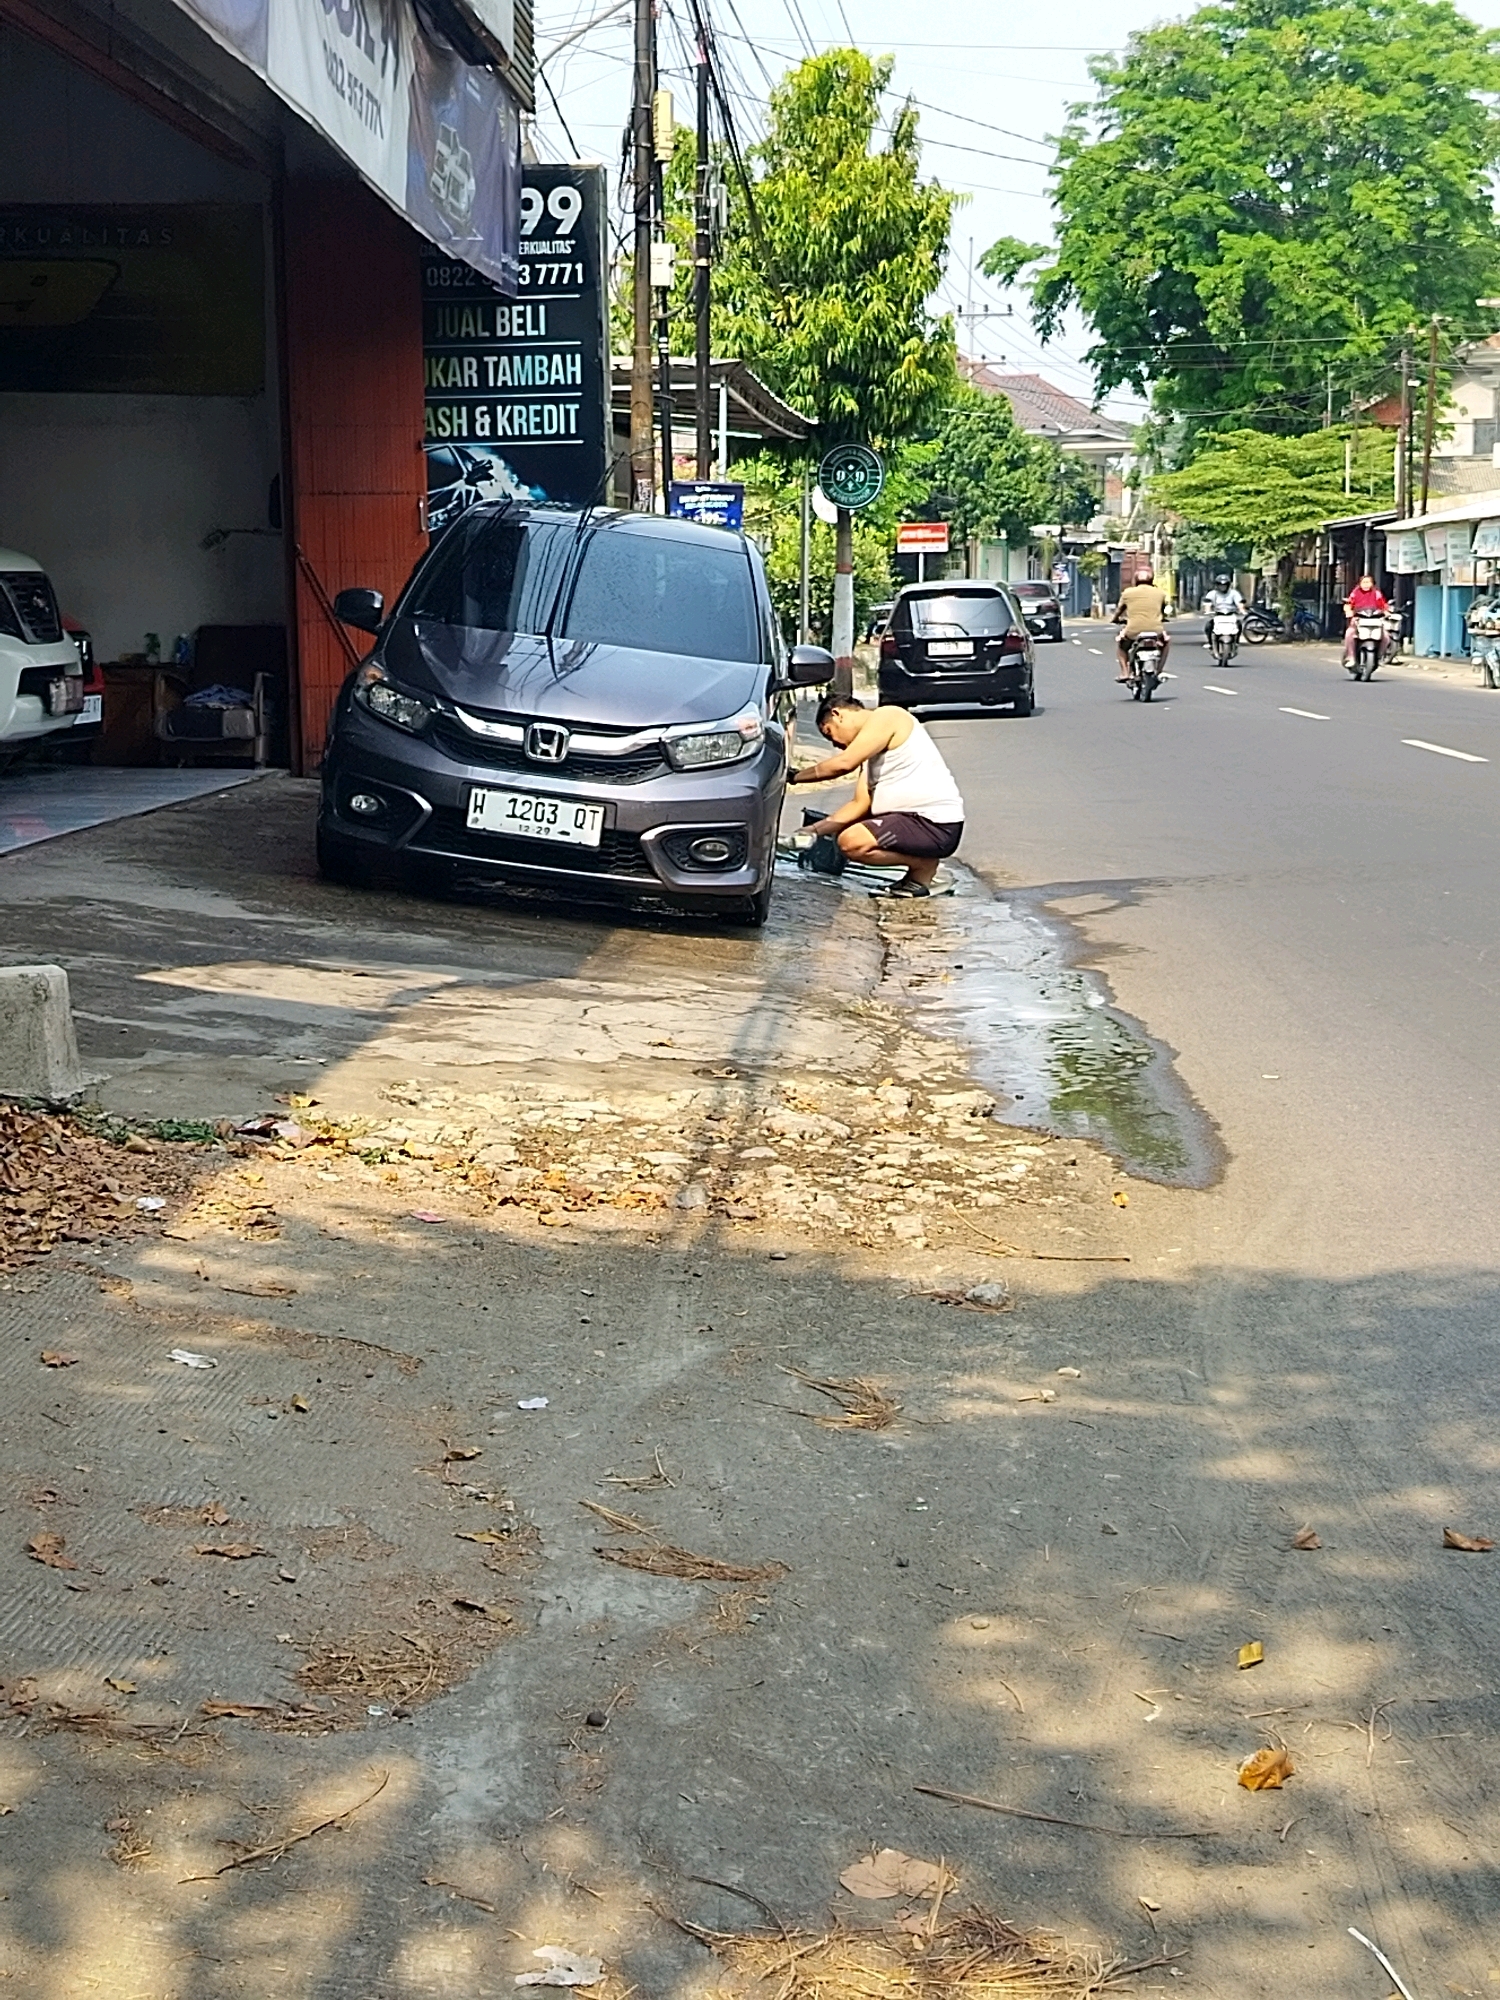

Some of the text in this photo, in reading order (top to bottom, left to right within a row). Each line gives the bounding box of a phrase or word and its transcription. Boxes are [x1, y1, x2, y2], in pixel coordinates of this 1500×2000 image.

[535, 262, 584, 285] 7771
[436, 304, 546, 338] JUAL BELI
[483, 353, 582, 388] TAMBAH
[424, 403, 580, 438] ASH & KREDIT
[505, 797, 559, 825] 1203
[573, 808, 600, 830] QT
